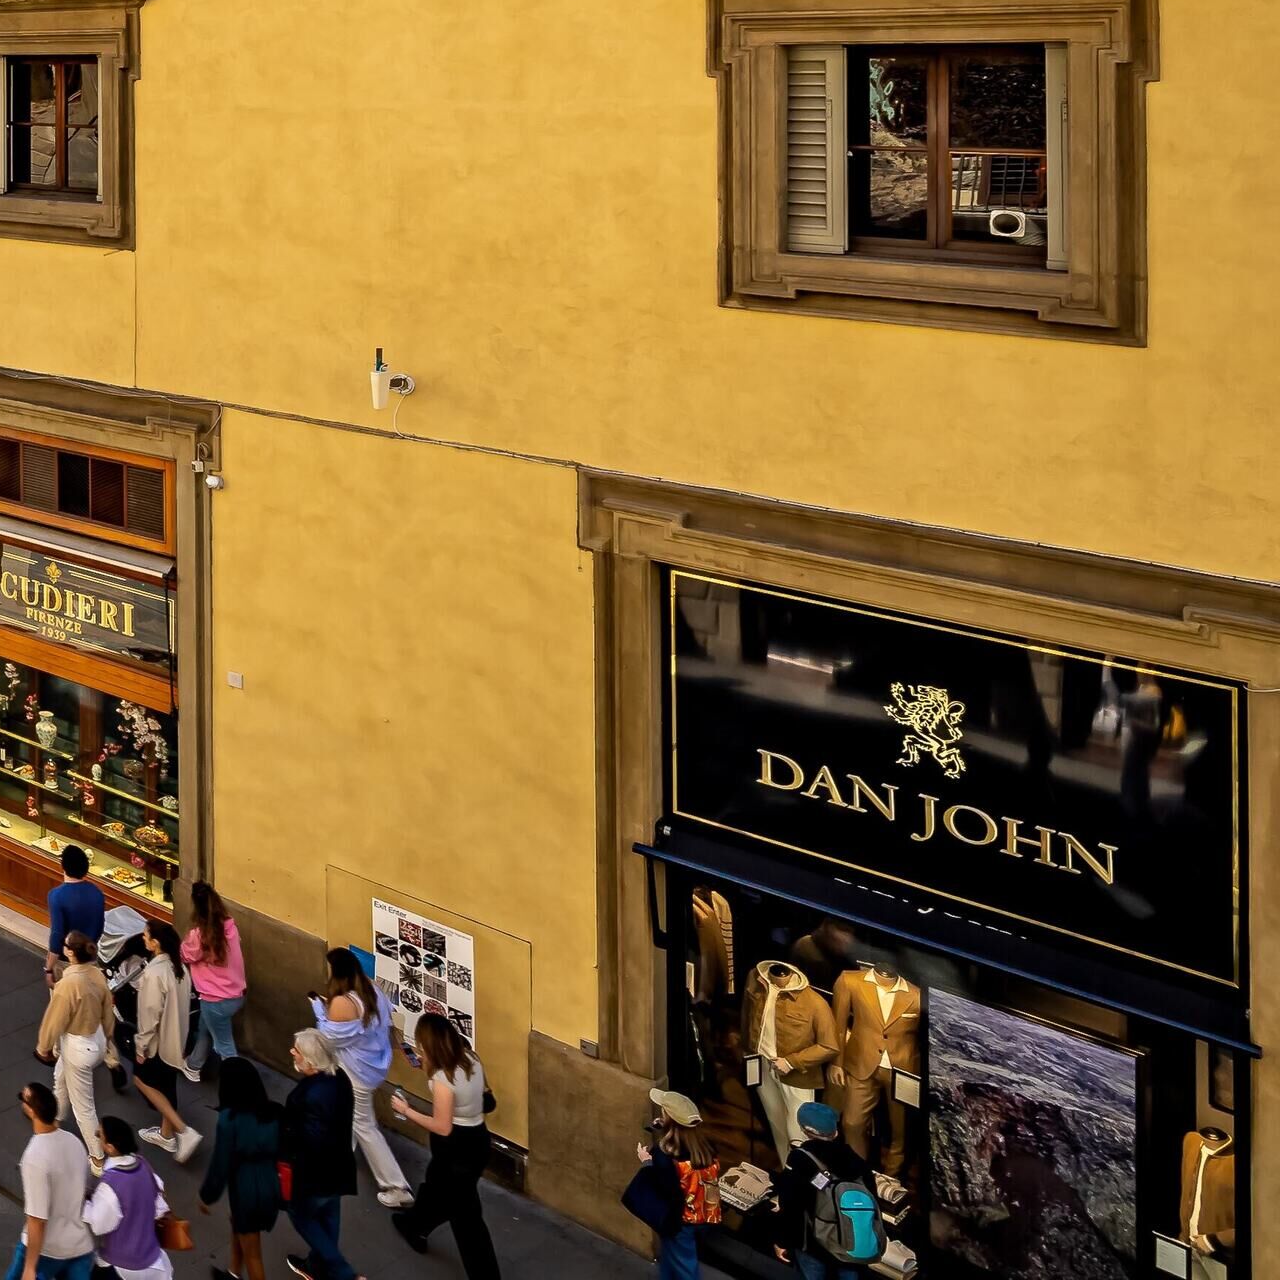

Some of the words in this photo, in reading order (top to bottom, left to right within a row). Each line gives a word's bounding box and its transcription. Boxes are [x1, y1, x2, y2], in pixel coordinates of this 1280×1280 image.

[25, 607, 82, 635] FIRENZE
[41, 626, 67, 641] 1939
[756, 748, 900, 822] DAN
[910, 792, 1119, 885] JOHN
[373, 900, 387, 911] Exit
